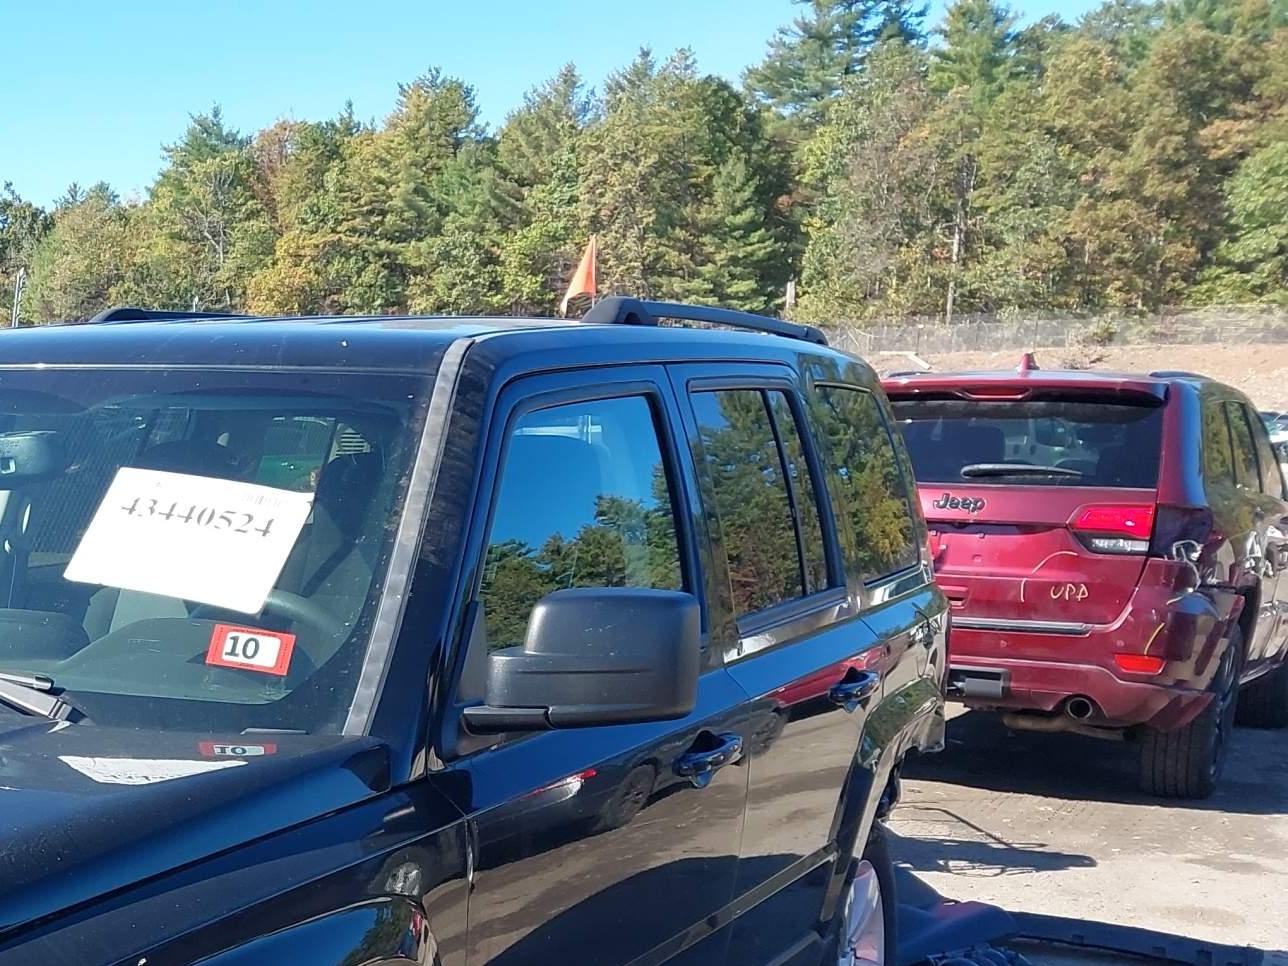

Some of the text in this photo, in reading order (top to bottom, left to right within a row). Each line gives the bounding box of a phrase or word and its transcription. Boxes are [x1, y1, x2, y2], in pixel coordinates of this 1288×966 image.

[933, 493, 986, 513] Jeep
[121, 497, 275, 537] 43440524
[224, 635, 260, 660] 10
